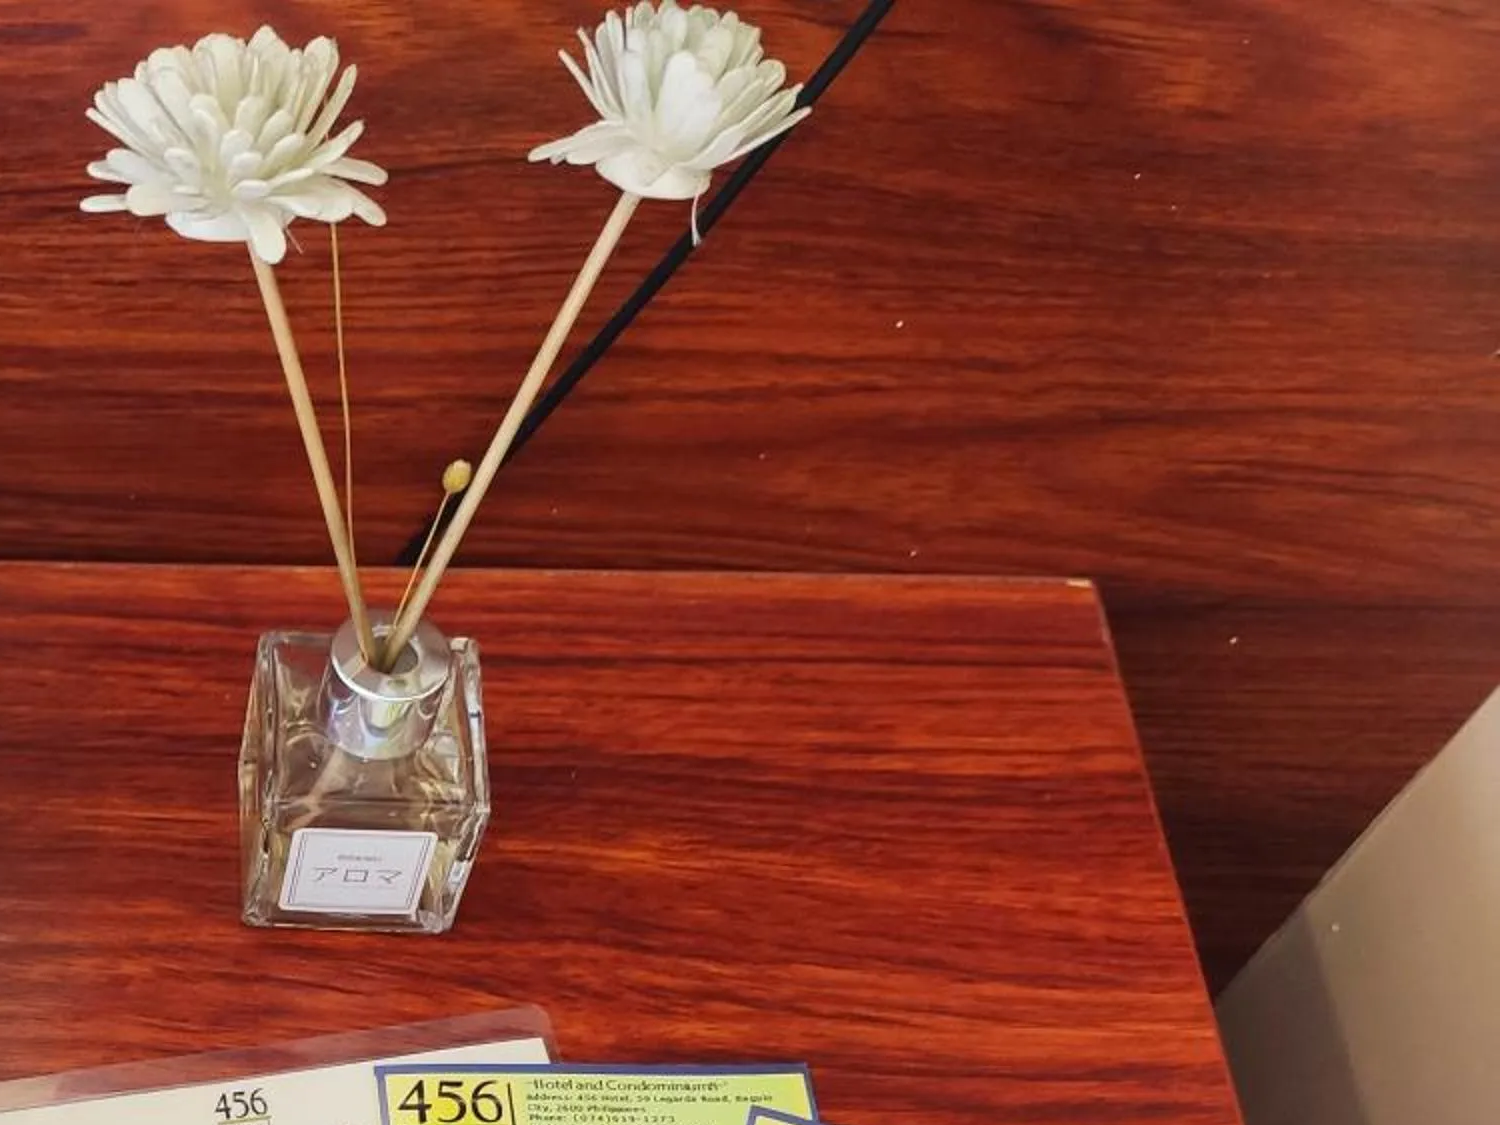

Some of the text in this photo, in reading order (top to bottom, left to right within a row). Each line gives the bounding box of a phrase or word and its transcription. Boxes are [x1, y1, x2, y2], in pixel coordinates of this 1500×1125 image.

[310, 867, 403, 885] アロマ
[575, 1079, 602, 1091] and
[214, 1088, 268, 1120] 456
[398, 1079, 504, 1125] 456
